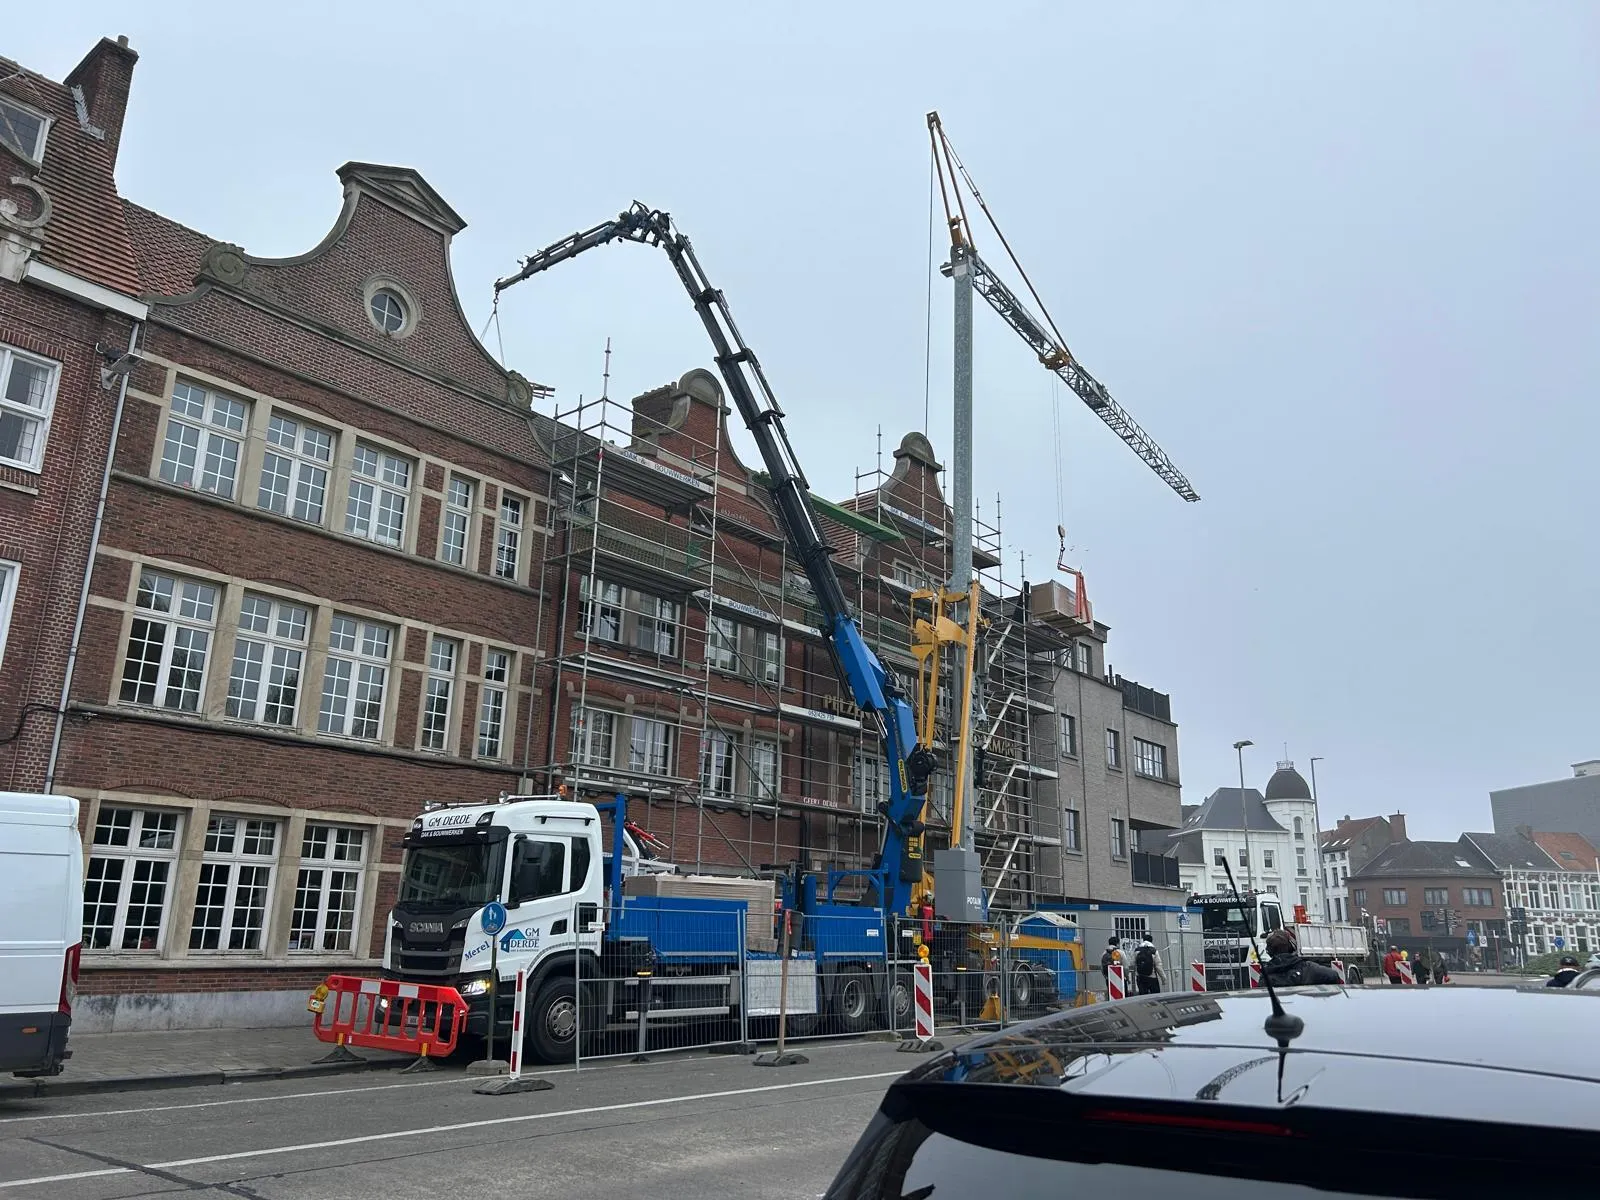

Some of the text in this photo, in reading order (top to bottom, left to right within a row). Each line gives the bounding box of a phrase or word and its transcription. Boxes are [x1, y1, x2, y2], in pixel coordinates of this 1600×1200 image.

[428, 814, 473, 827] GM DERDE
[433, 829, 464, 837] BOUWWERKEN
[409, 921, 444, 933] SCANIA
[525, 927, 540, 936] GM
[510, 939, 540, 949] DERDE
[464, 940, 491, 961] Merel
